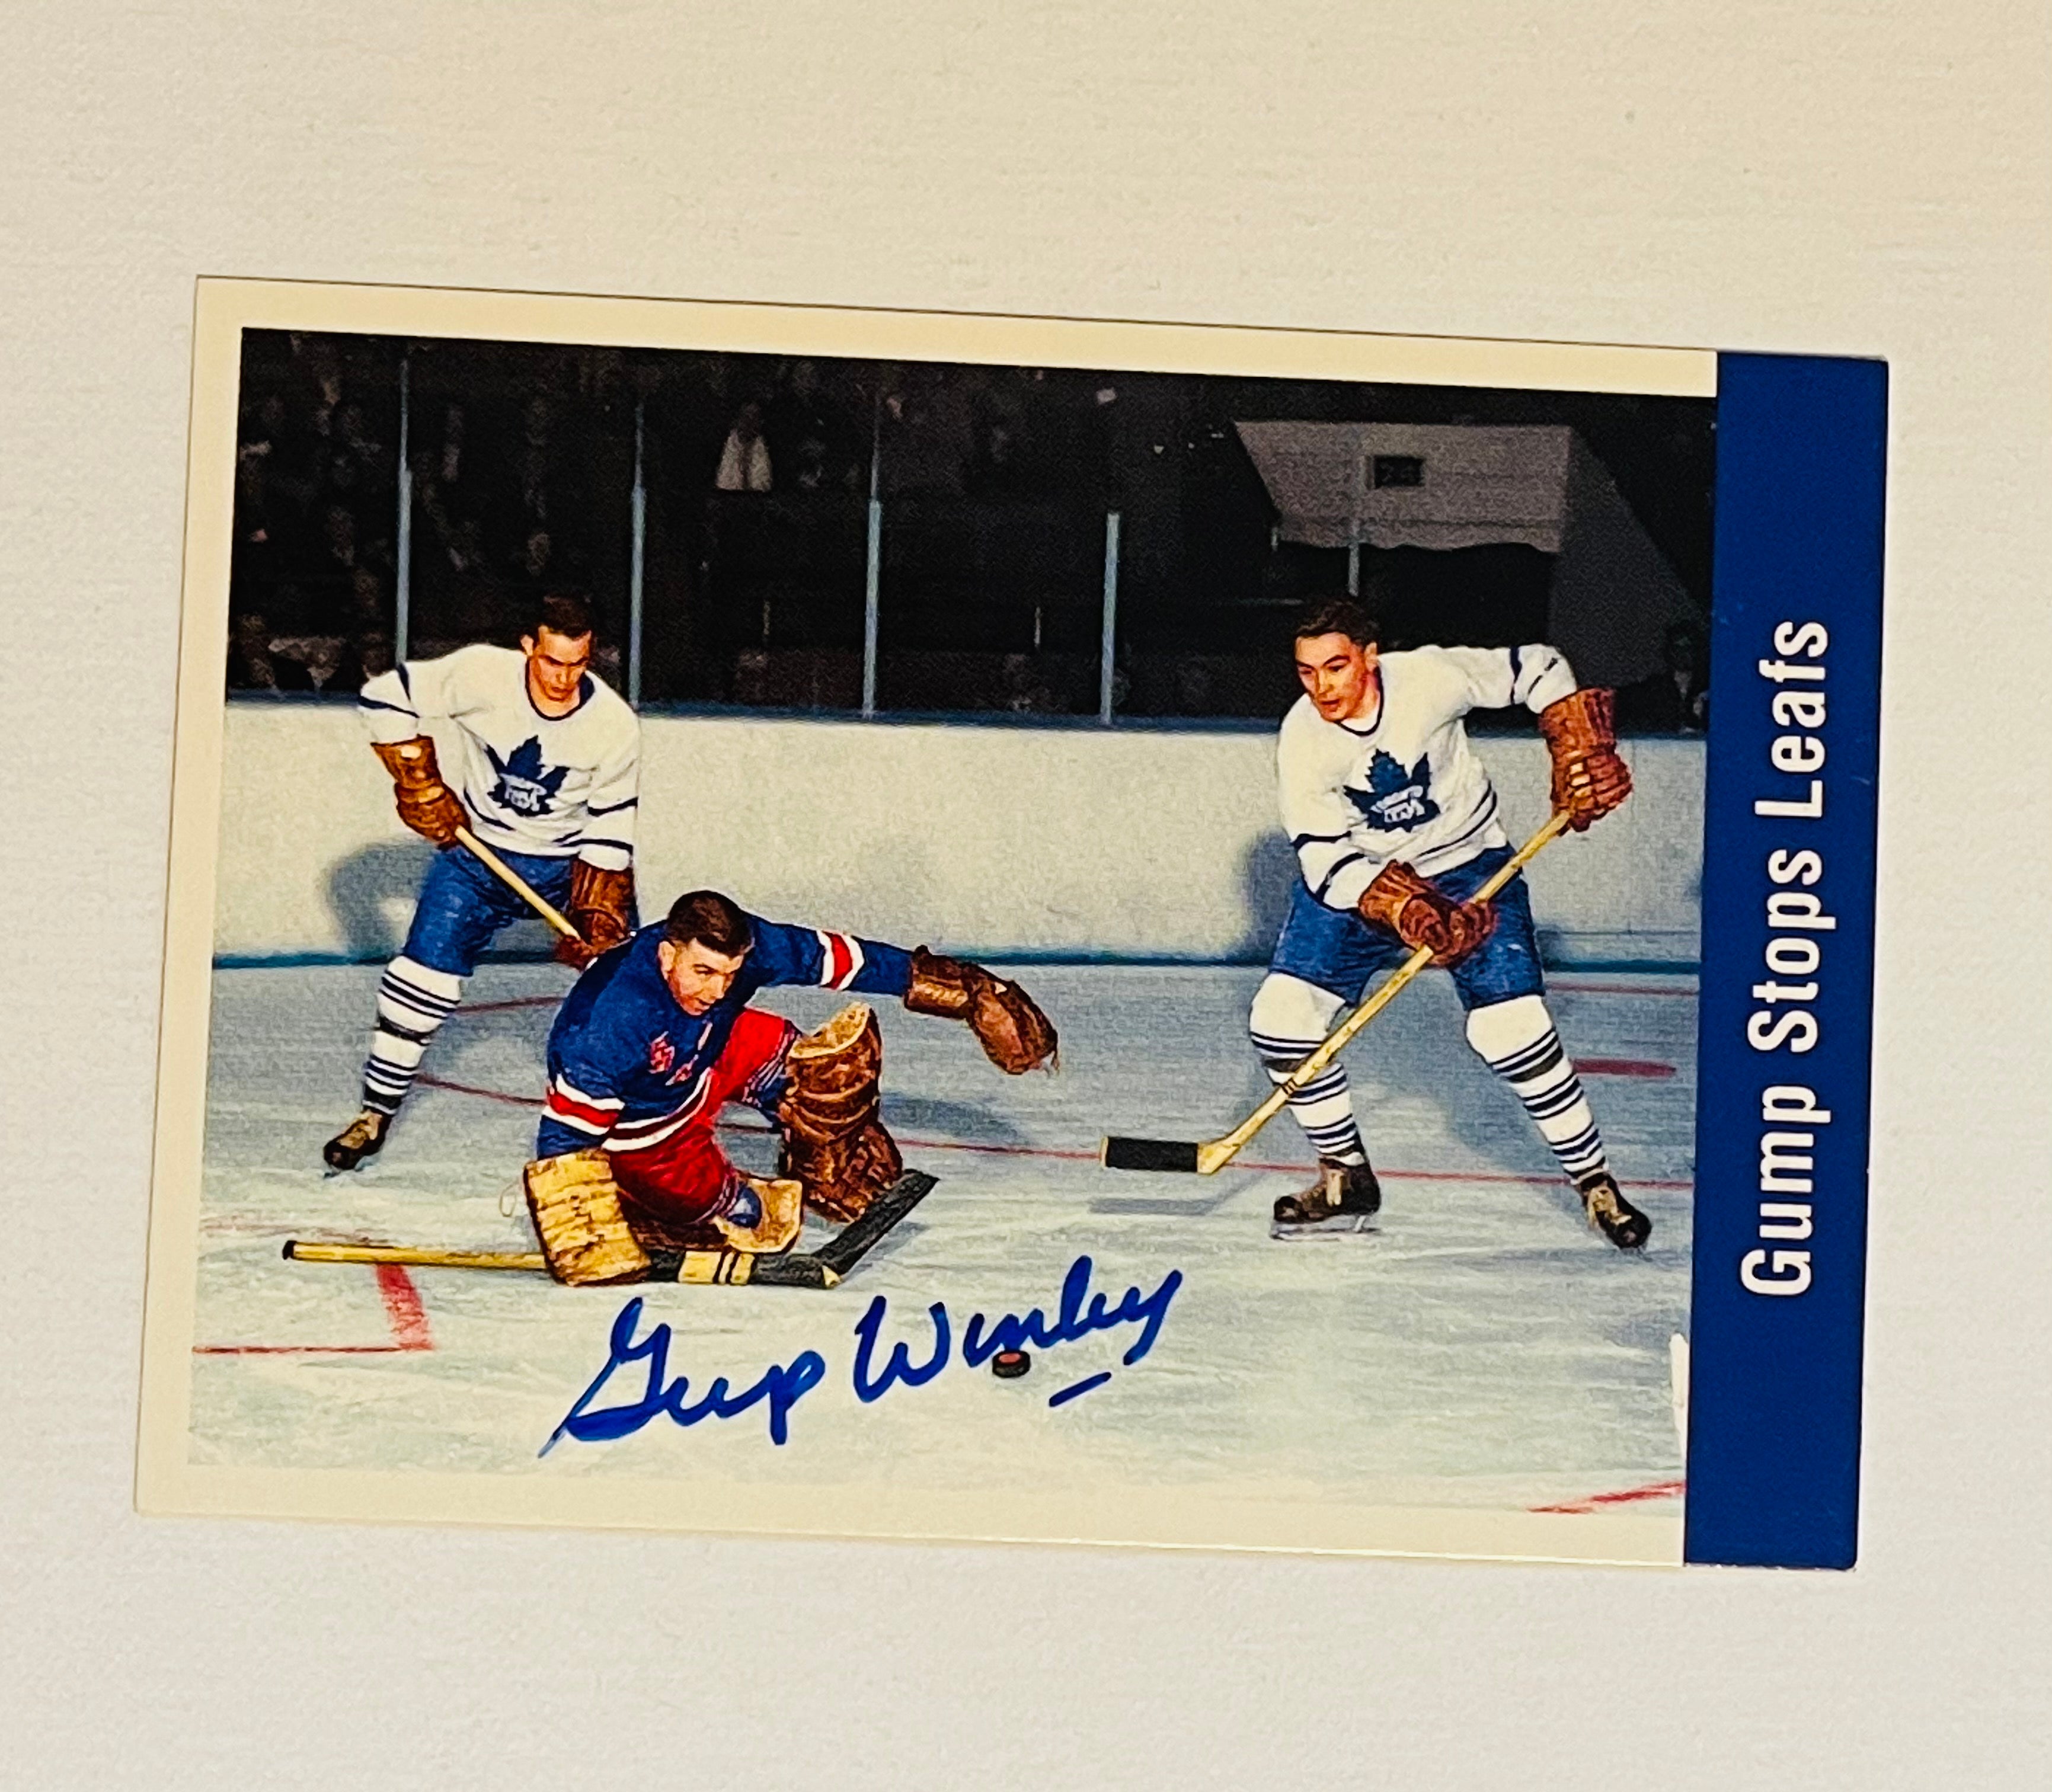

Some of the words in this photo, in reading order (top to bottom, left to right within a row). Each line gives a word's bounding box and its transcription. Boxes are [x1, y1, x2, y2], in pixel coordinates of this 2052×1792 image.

[1754, 620, 1829, 818] Leafs
[1747, 849, 1837, 1053] Stops
[1740, 1085, 1832, 1297] Gump
